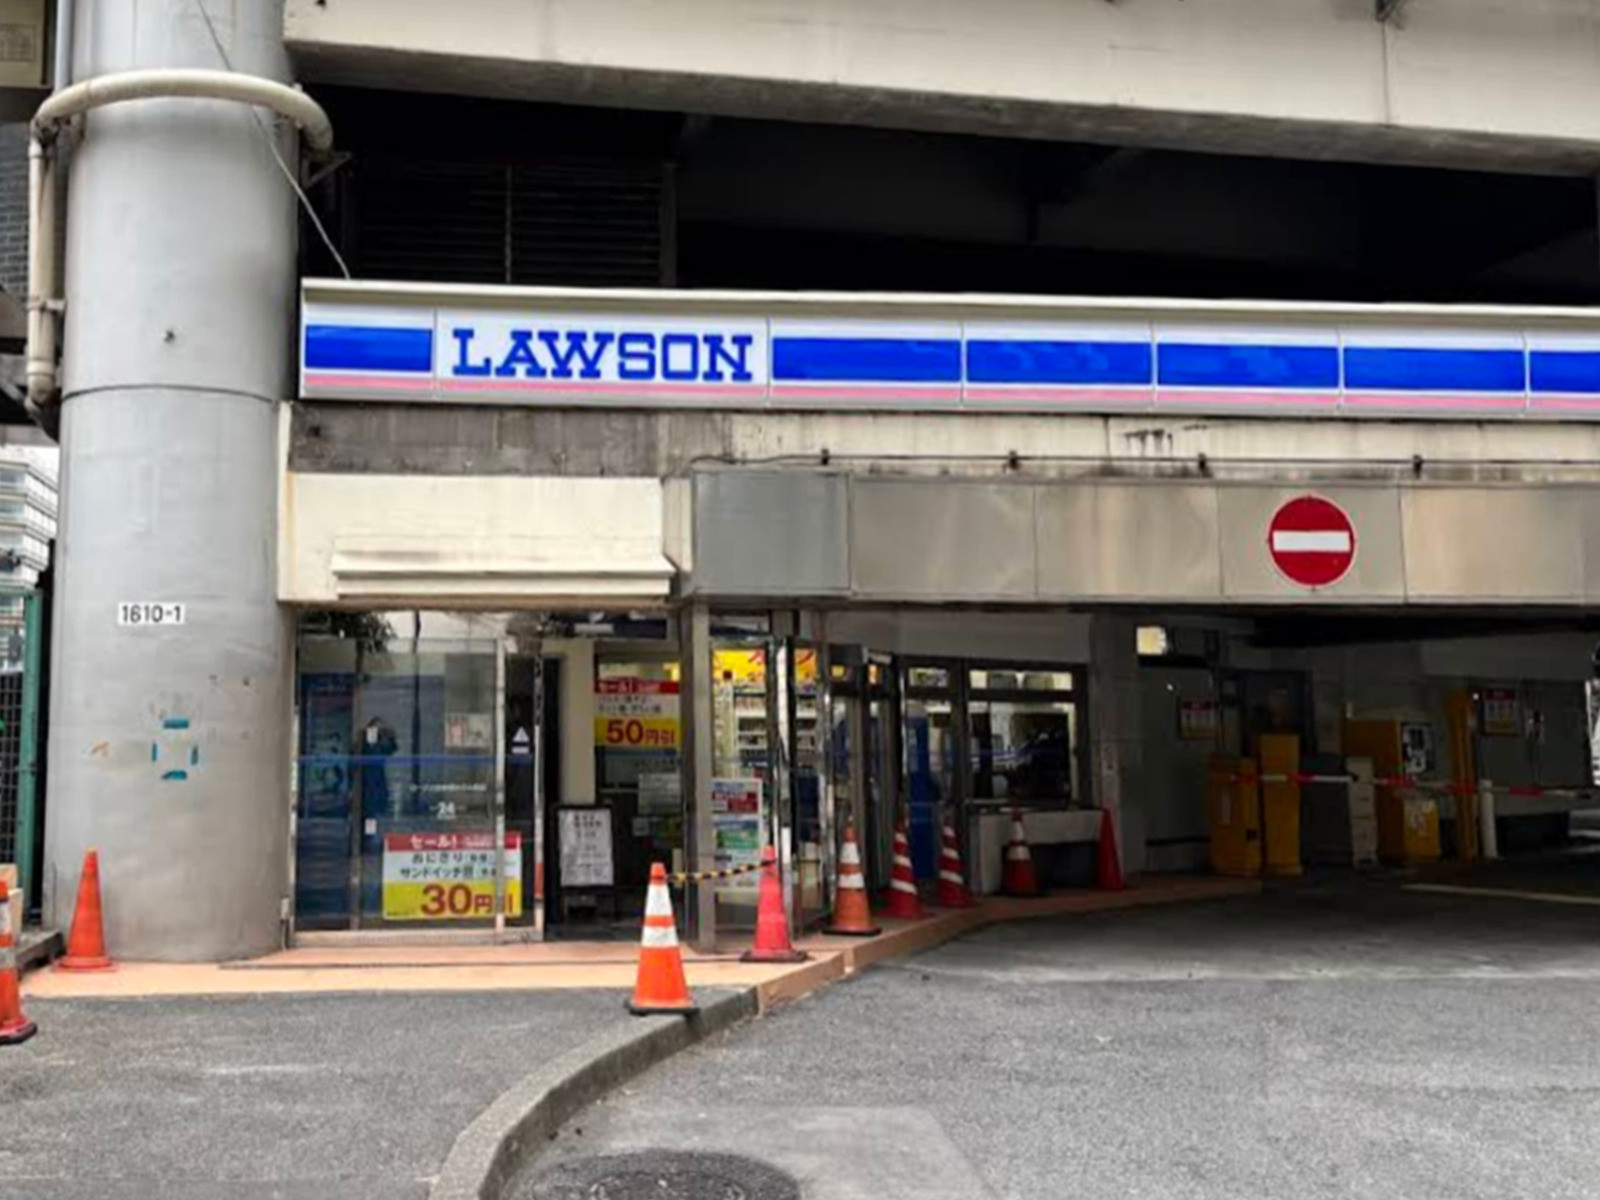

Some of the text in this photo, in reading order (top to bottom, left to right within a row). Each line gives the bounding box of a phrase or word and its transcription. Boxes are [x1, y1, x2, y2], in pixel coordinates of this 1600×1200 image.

[452, 328, 753, 382] LAWSON
[122, 604, 181, 623] 1610-1
[606, 719, 675, 744] 50円引
